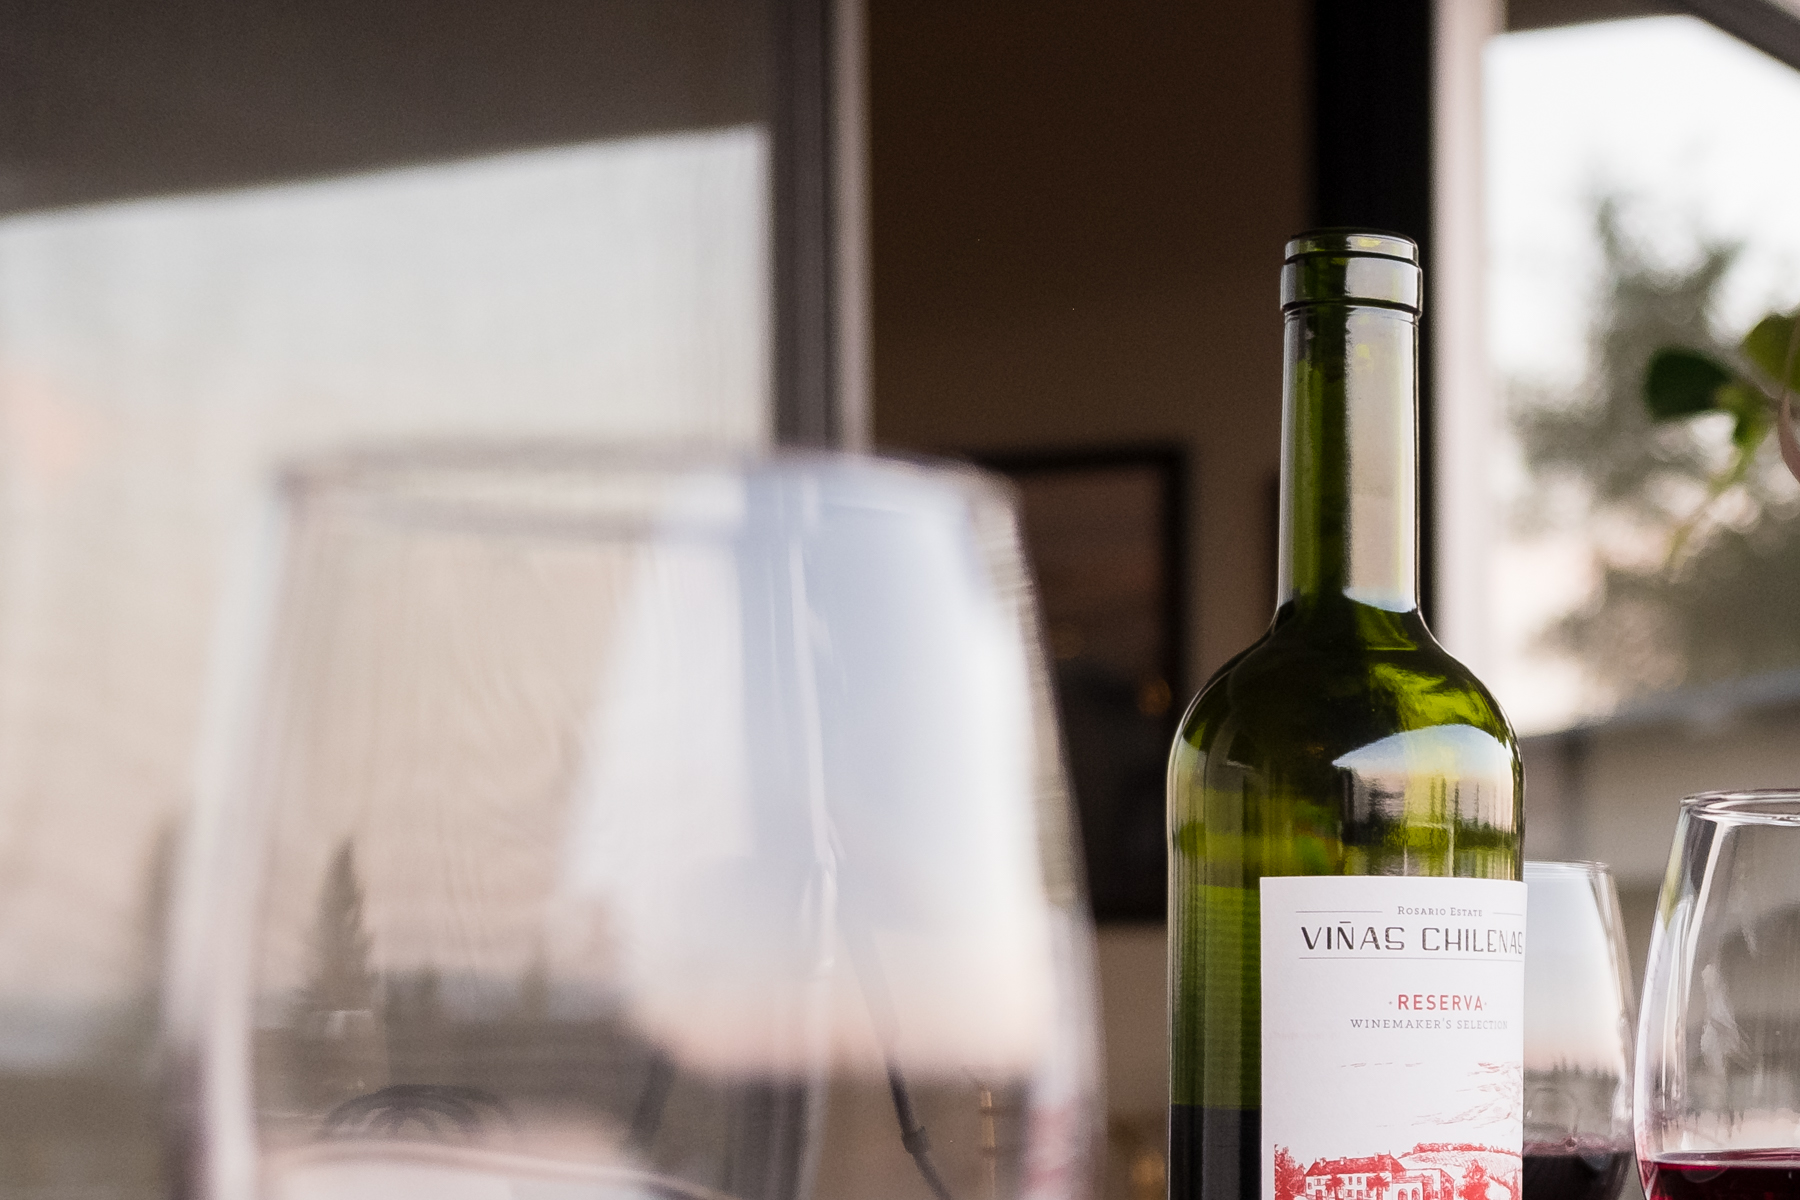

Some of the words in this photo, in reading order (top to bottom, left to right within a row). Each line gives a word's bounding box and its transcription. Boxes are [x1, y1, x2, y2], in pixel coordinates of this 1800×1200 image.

[1300, 920, 1405, 951] VIÑAS
[1421, 927, 1523, 955] CHILENAS
[1397, 994, 1483, 1011] RESERVA
[1350, 1017, 1452, 1029] WINEMAKER'S
[1457, 1019, 1508, 1030] SELECTION
